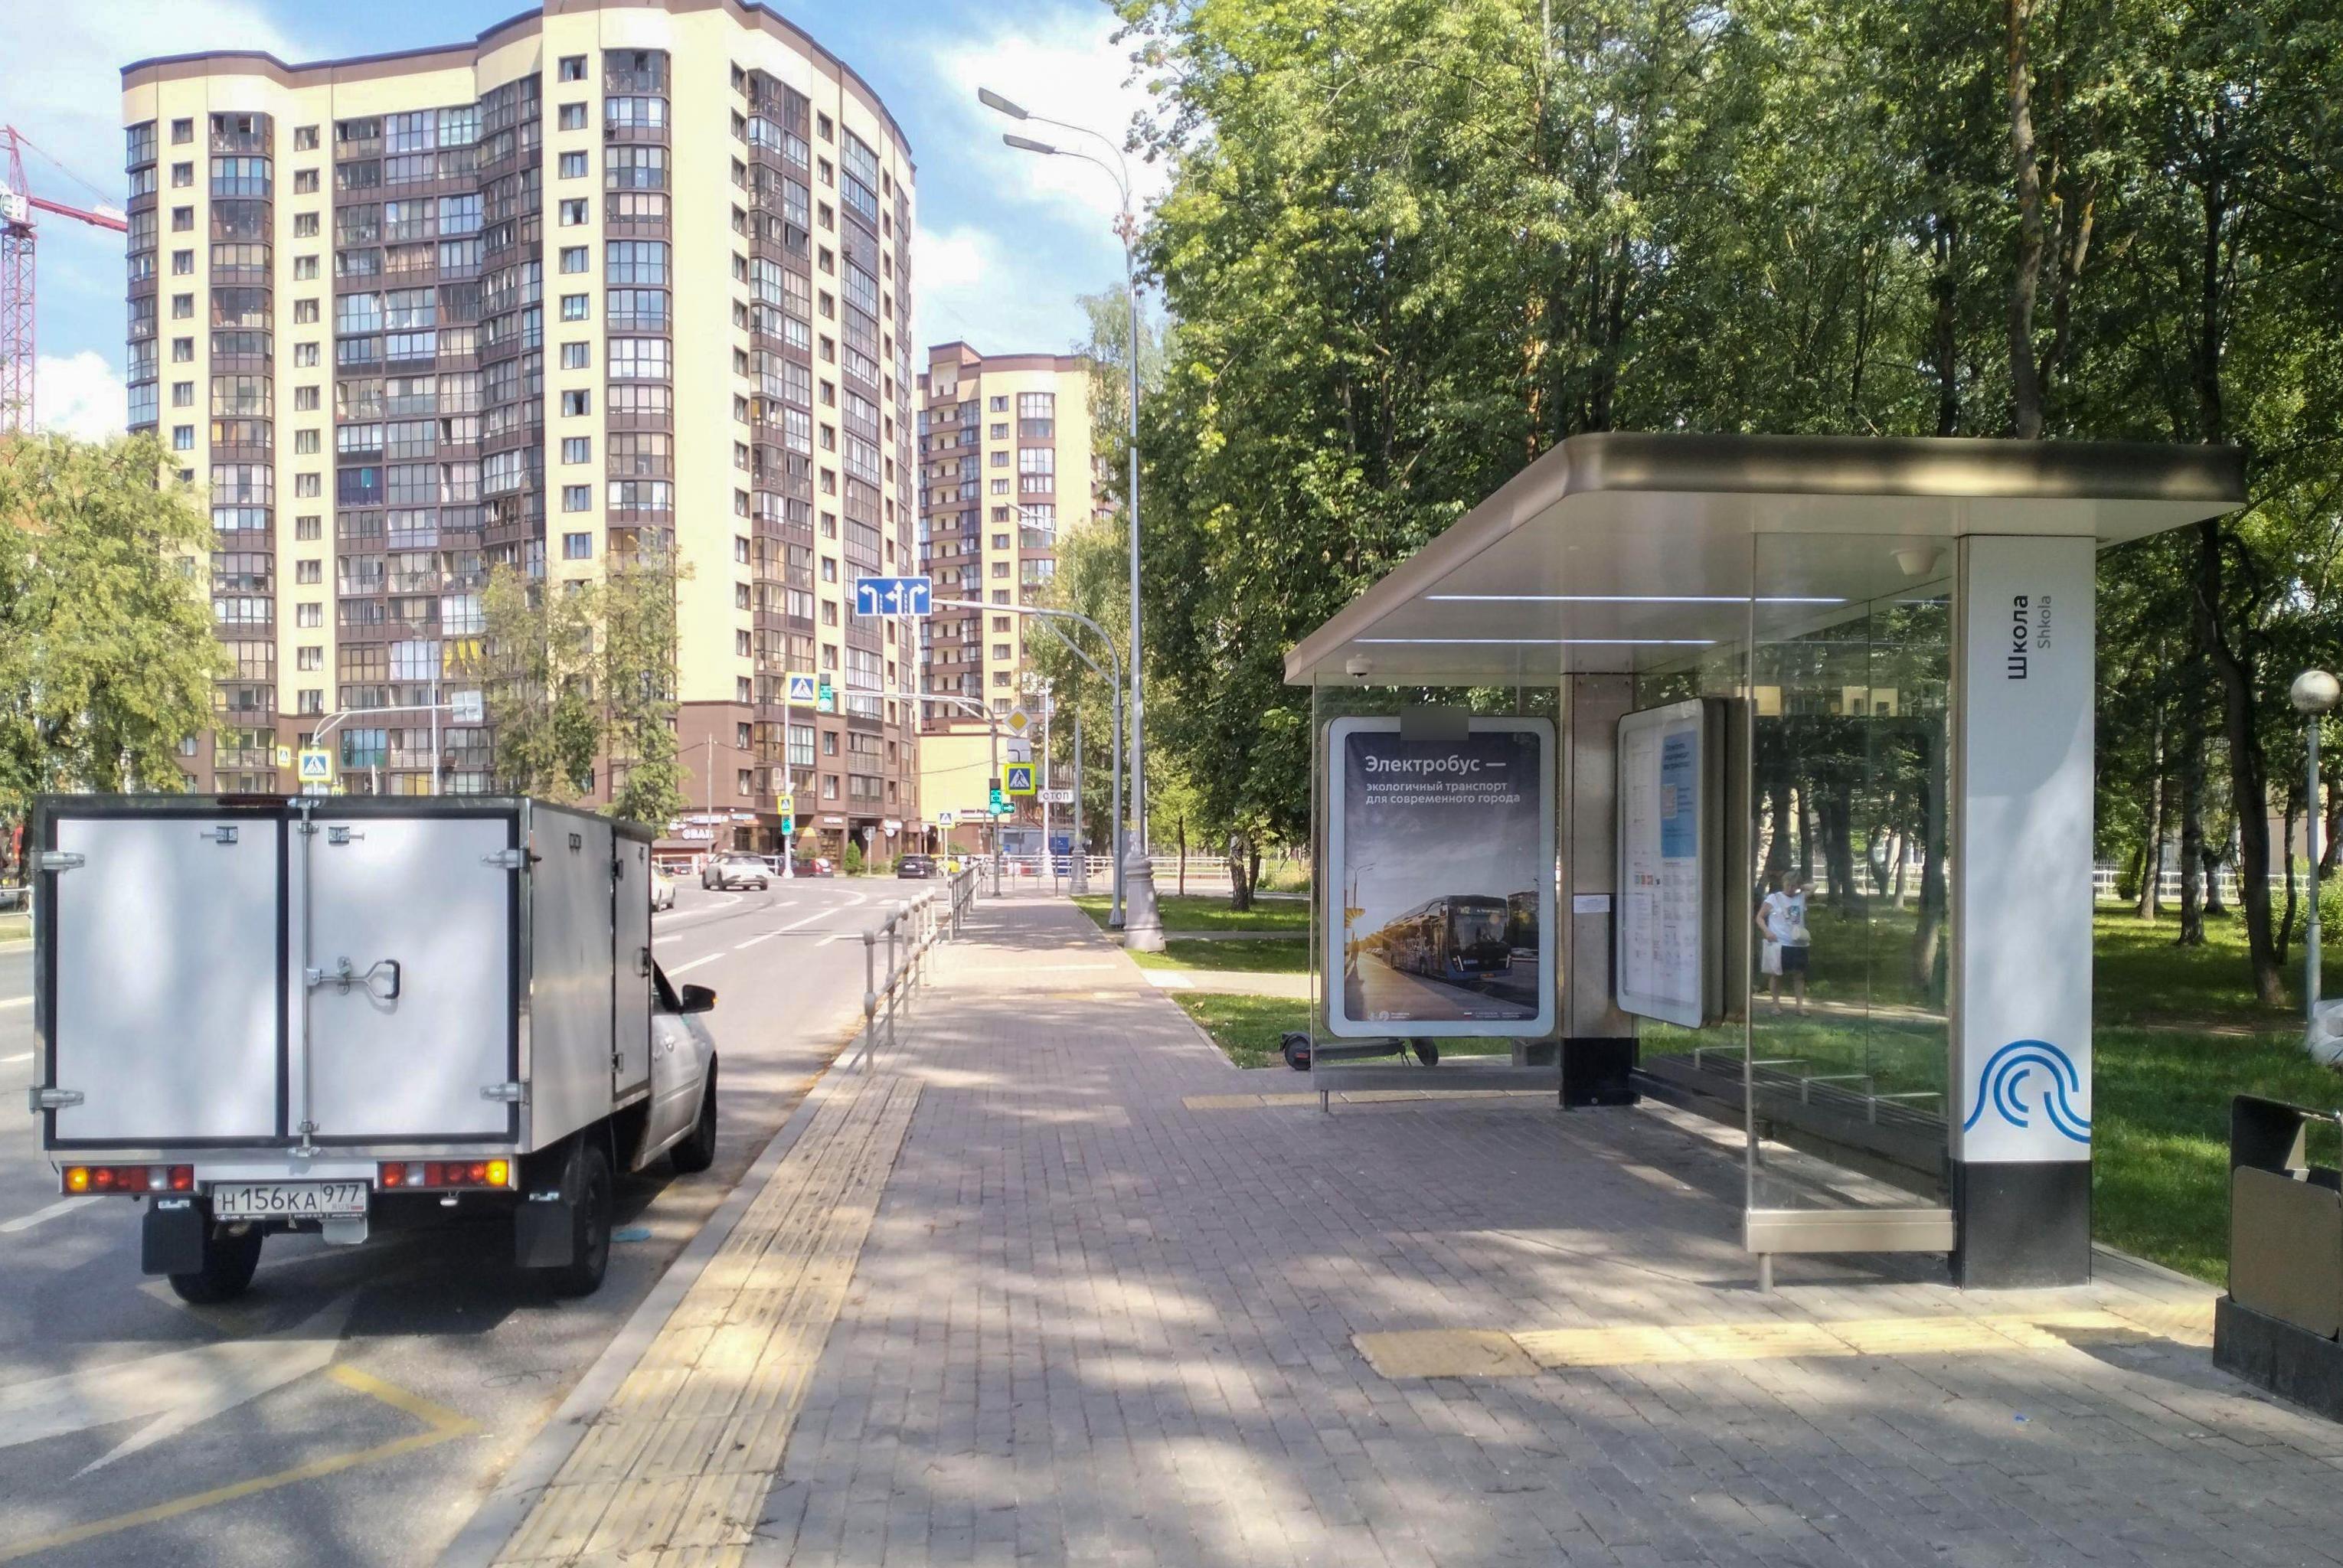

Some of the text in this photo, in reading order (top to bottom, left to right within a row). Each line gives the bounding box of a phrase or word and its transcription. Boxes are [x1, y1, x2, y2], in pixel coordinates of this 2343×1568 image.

[2037, 596, 2052, 649] Shkola
[2008, 595, 2028, 680] Школа
[1365, 755, 1480, 776] Электробус
[1042, 791, 1070, 801] СТОП
[1366, 781, 1508, 793] экологичный транспорт
[1365, 793, 1521, 805] для современного города
[222, 1184, 359, 1211] Н156КА 977
